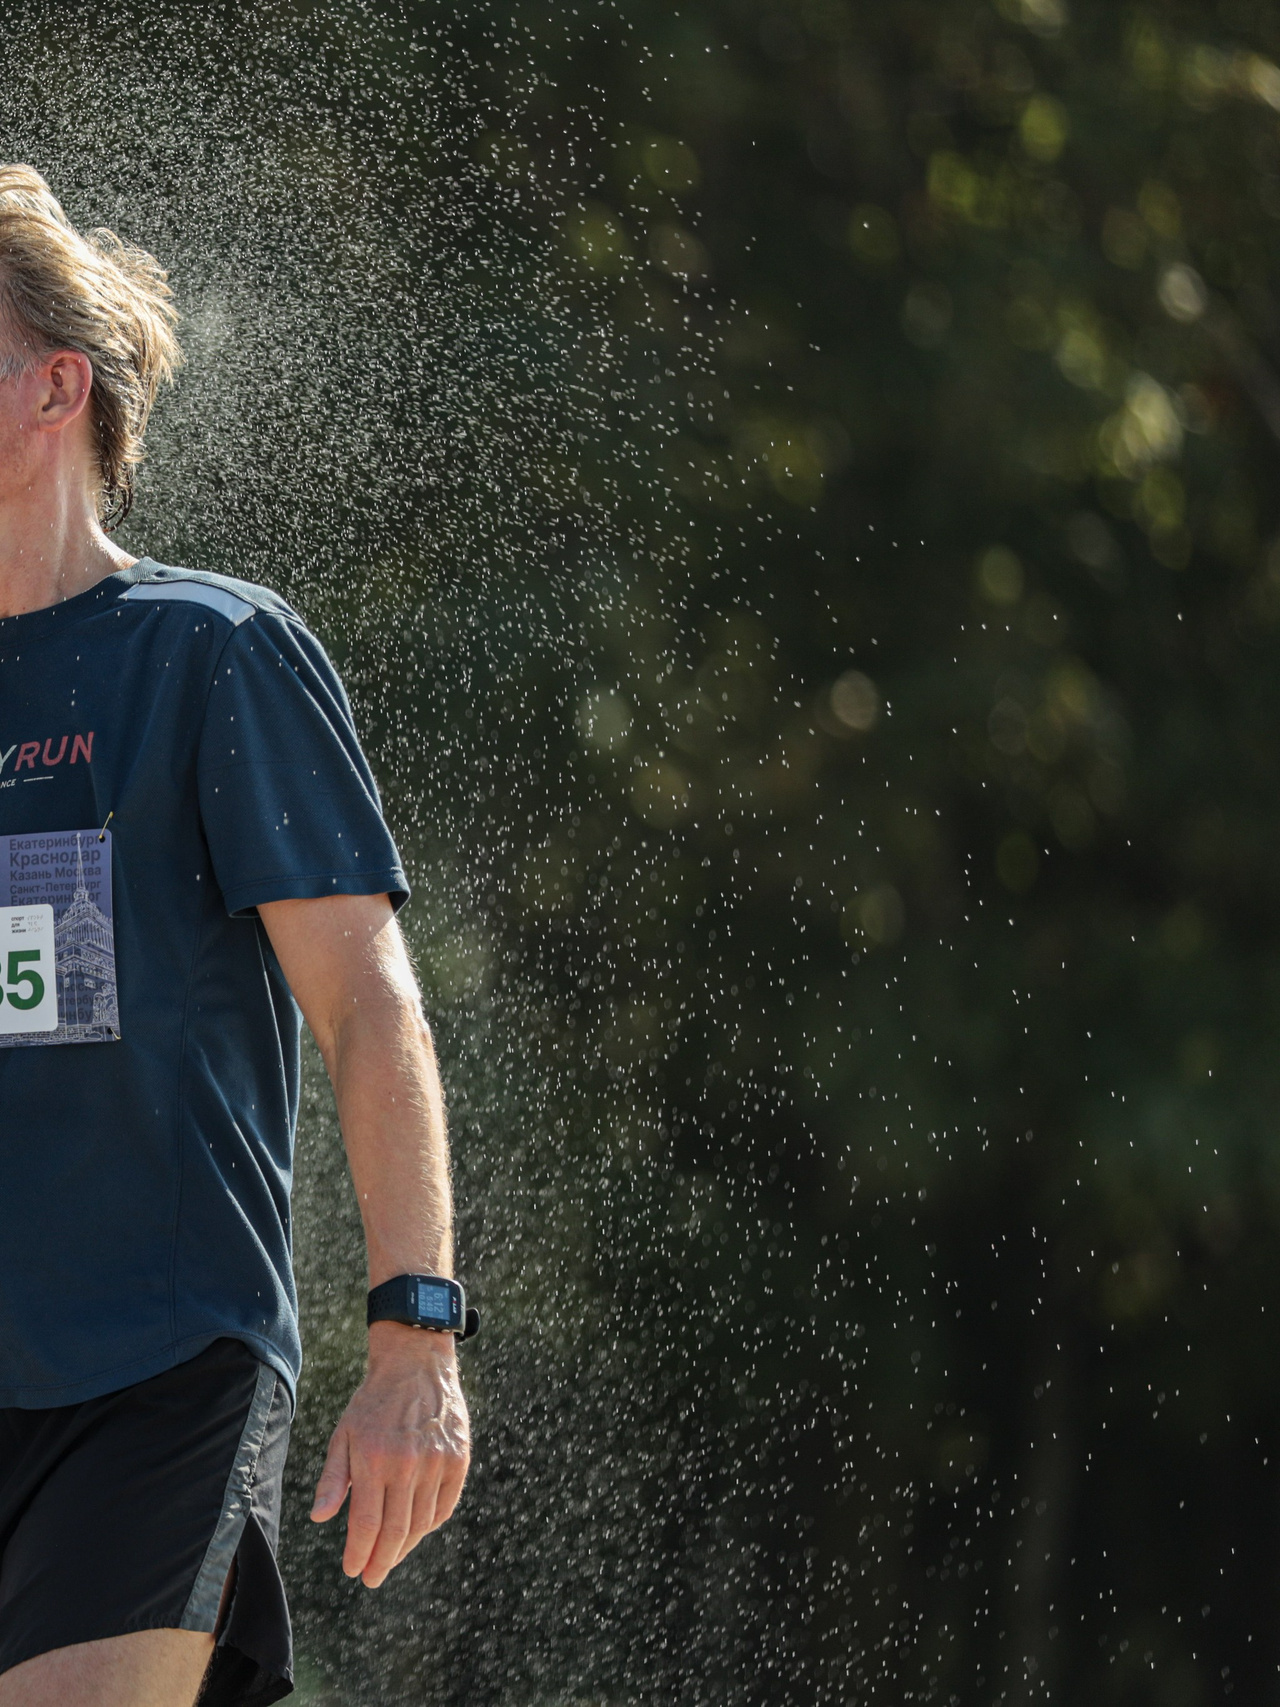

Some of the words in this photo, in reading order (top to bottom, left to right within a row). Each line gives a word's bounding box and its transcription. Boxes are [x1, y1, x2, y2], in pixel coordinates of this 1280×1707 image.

[10, 849, 101, 869] Краснодар
[10, 870, 52, 881] Казань
[10, 880, 101, 895] Санкт-Петерург
